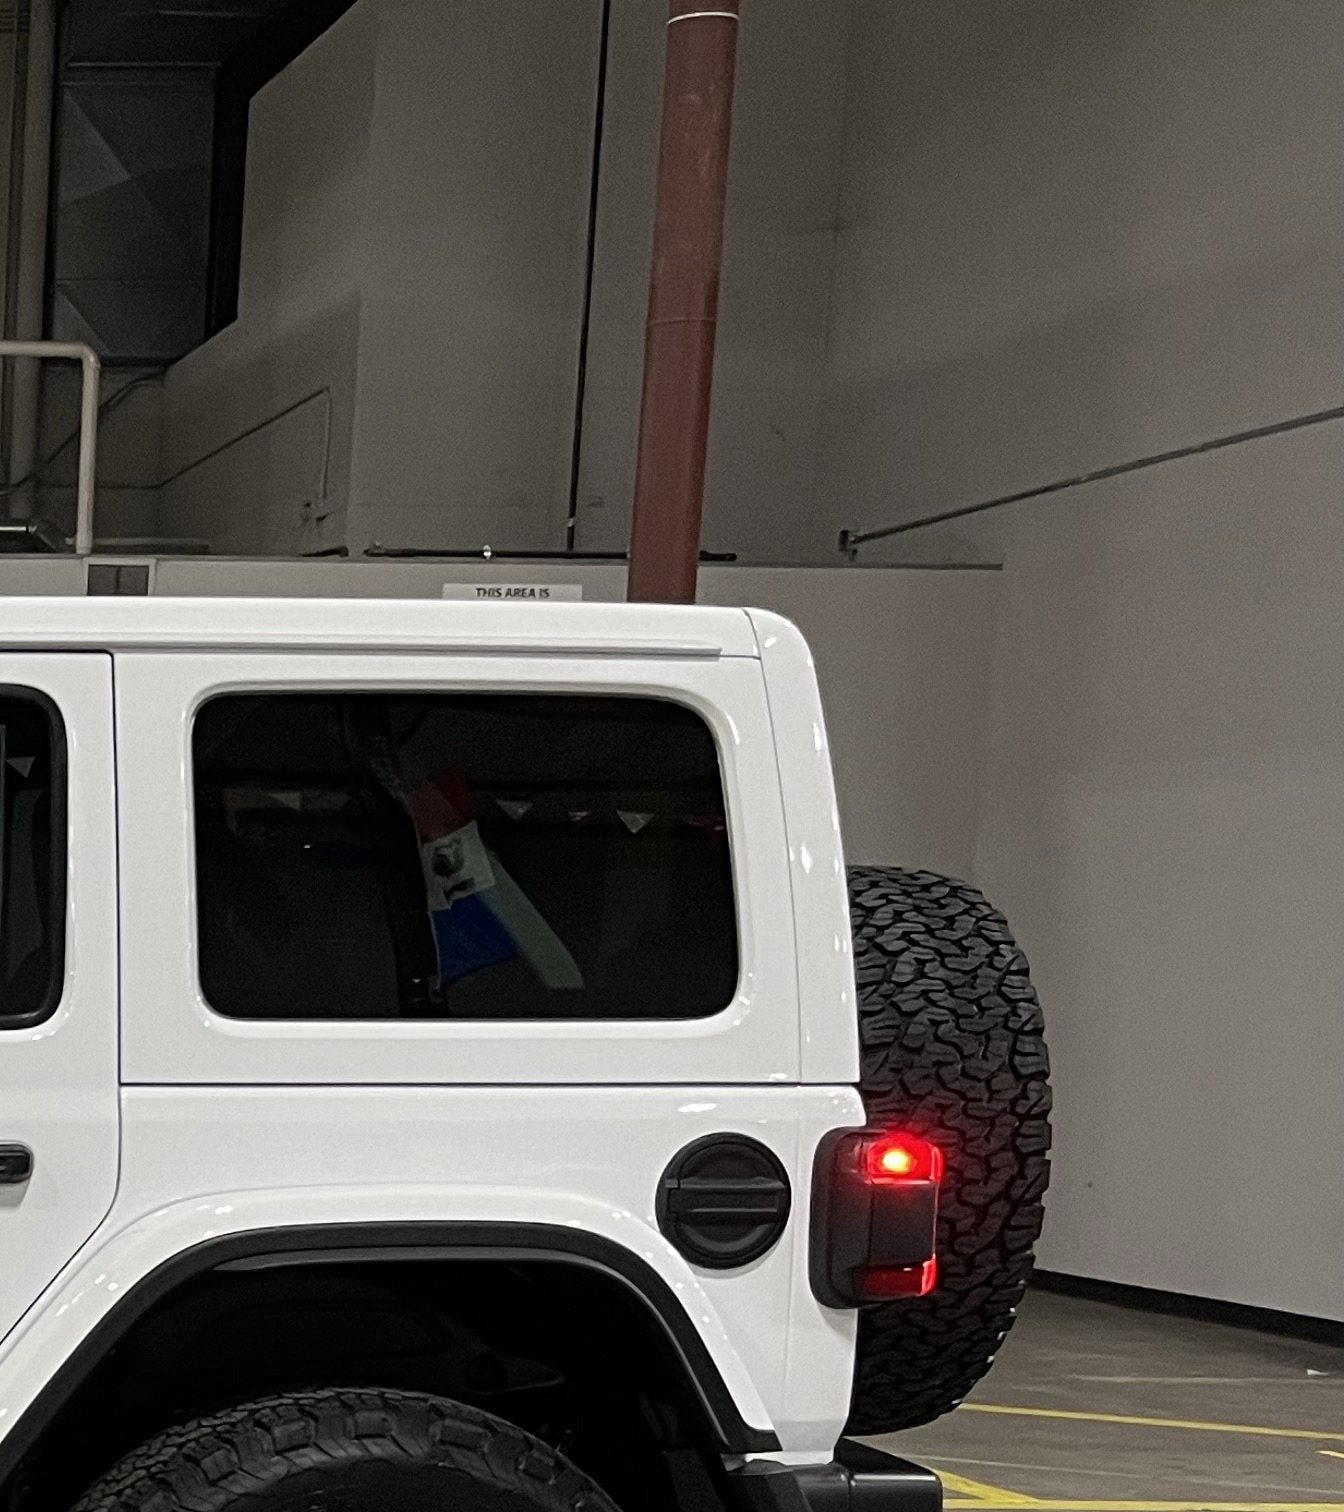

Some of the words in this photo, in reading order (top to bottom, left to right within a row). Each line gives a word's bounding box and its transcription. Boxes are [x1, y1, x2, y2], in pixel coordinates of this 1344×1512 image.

[475, 587, 502, 598] THIS
[505, 587, 535, 598] AREA
[538, 587, 550, 598] IS
